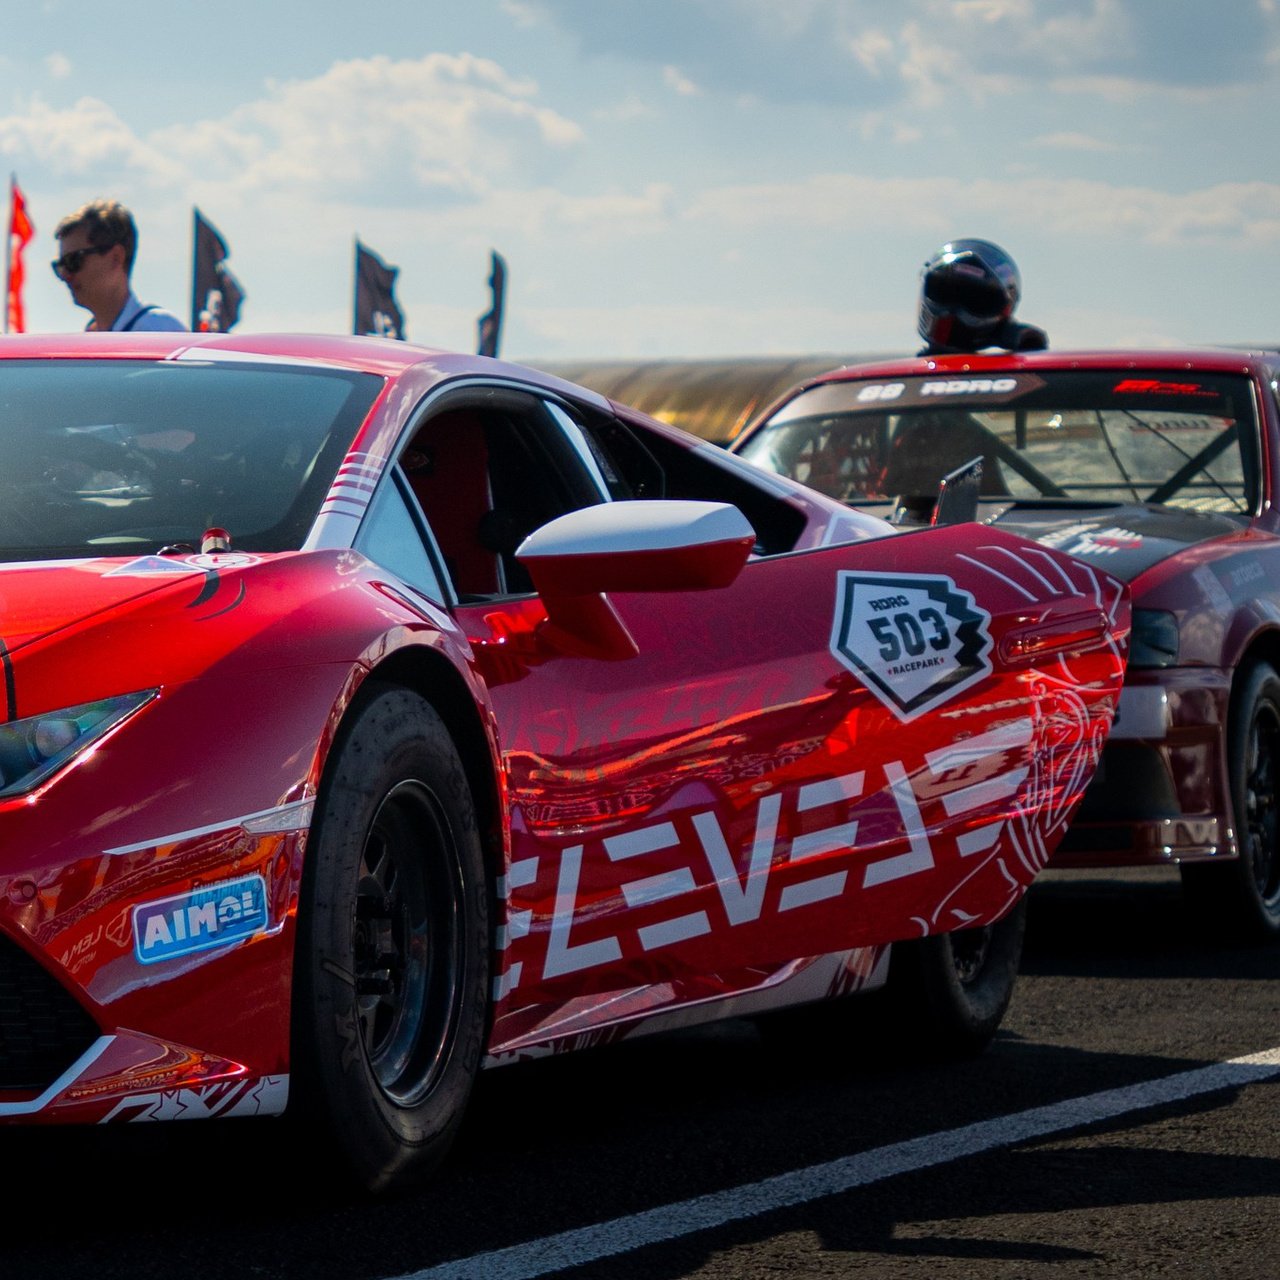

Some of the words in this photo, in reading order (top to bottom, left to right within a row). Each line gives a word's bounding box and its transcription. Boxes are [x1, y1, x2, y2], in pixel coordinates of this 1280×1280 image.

[868, 594, 910, 612] RDRC
[866, 607, 952, 663] 503
[892, 656, 941, 675] RACEPARK
[143, 891, 262, 951] AIMOL
